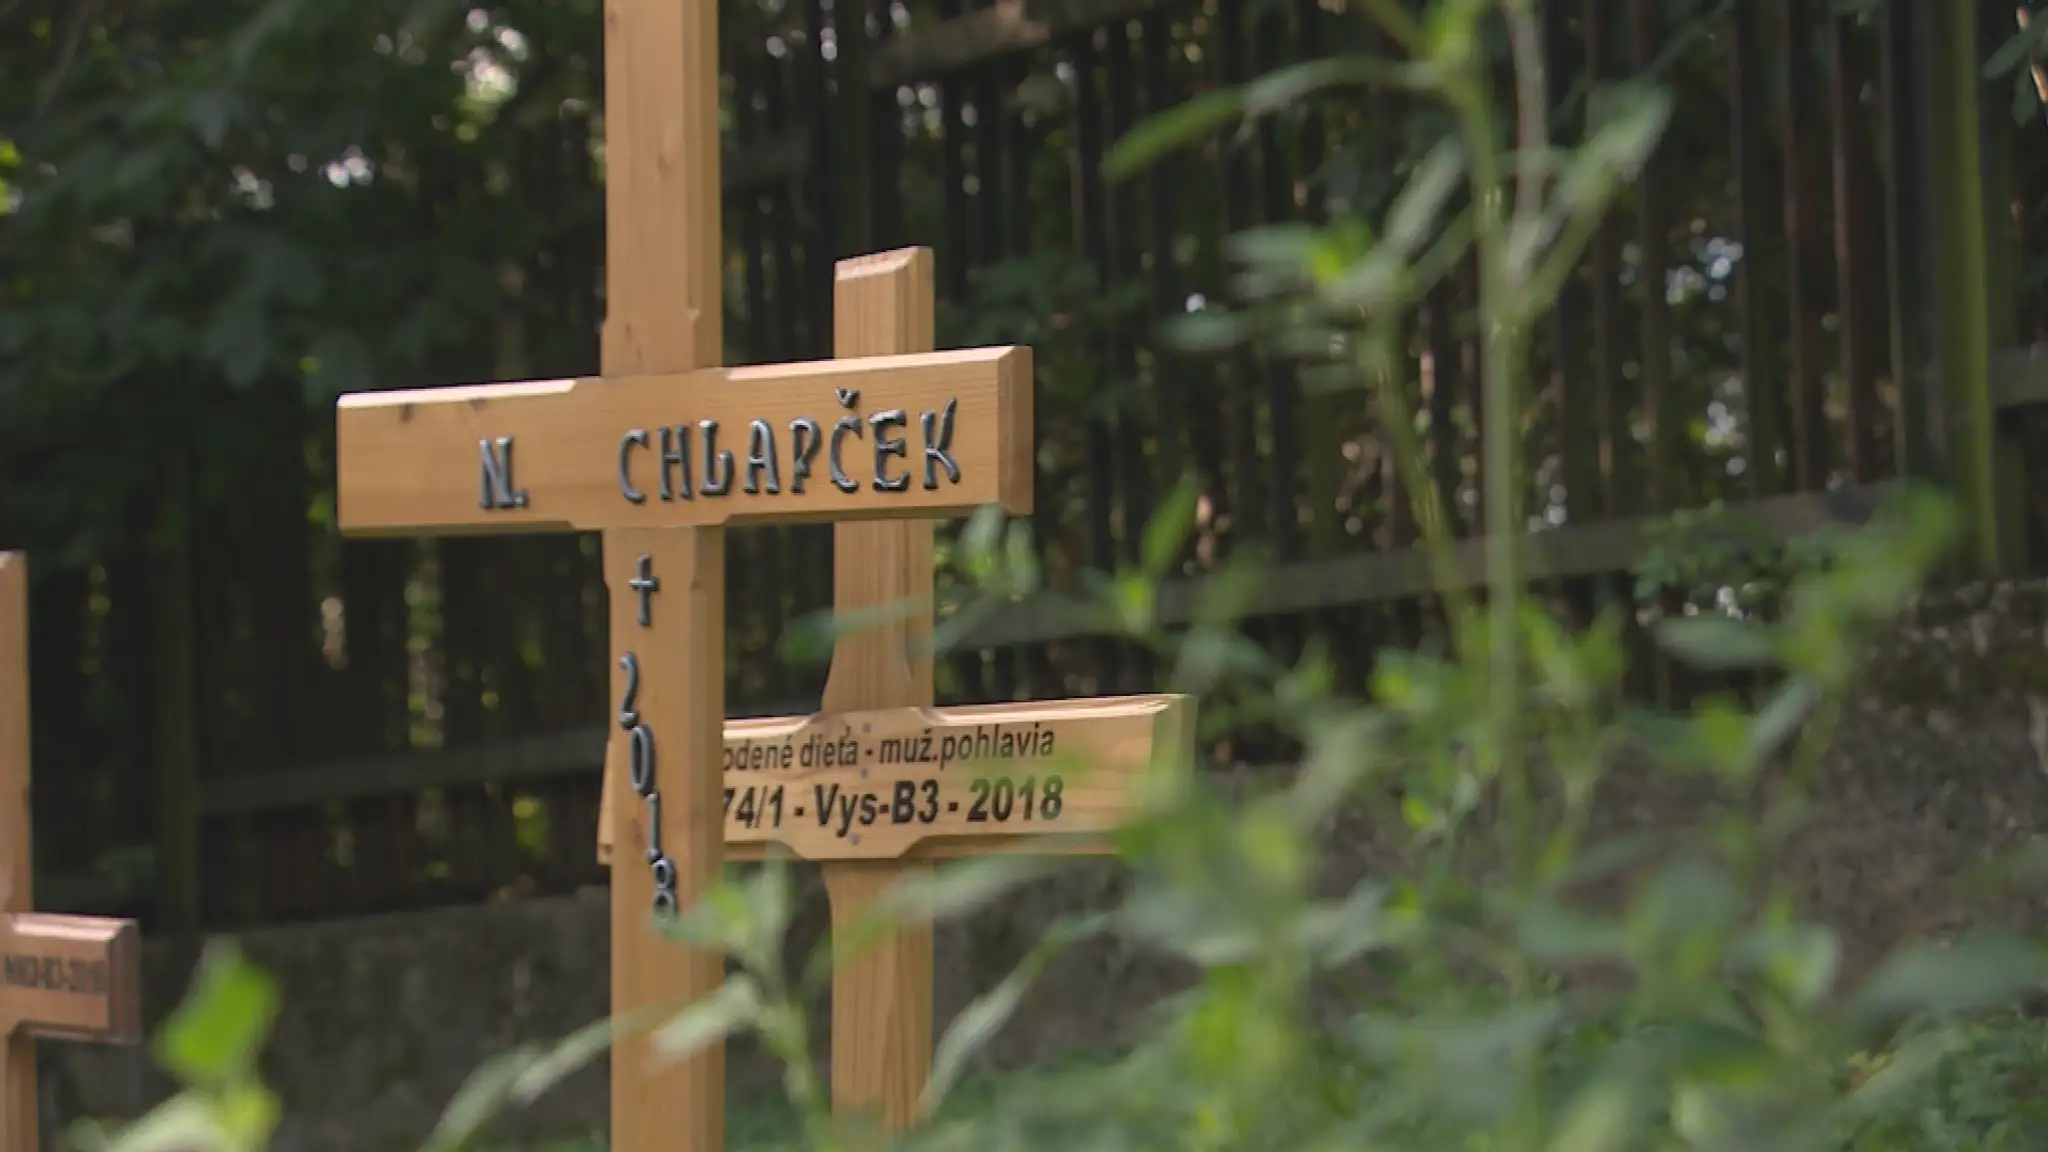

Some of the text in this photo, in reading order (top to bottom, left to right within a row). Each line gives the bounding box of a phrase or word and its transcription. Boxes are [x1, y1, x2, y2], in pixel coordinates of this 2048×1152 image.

[479, 387, 960, 509] N. CHLAPČEK
[800, 726, 859, 769] dieťa
[878, 722, 1056, 770] muž.pohlavia
[814, 779, 940, 838] Vys-B3
[966, 775, 1064, 823] 2018
